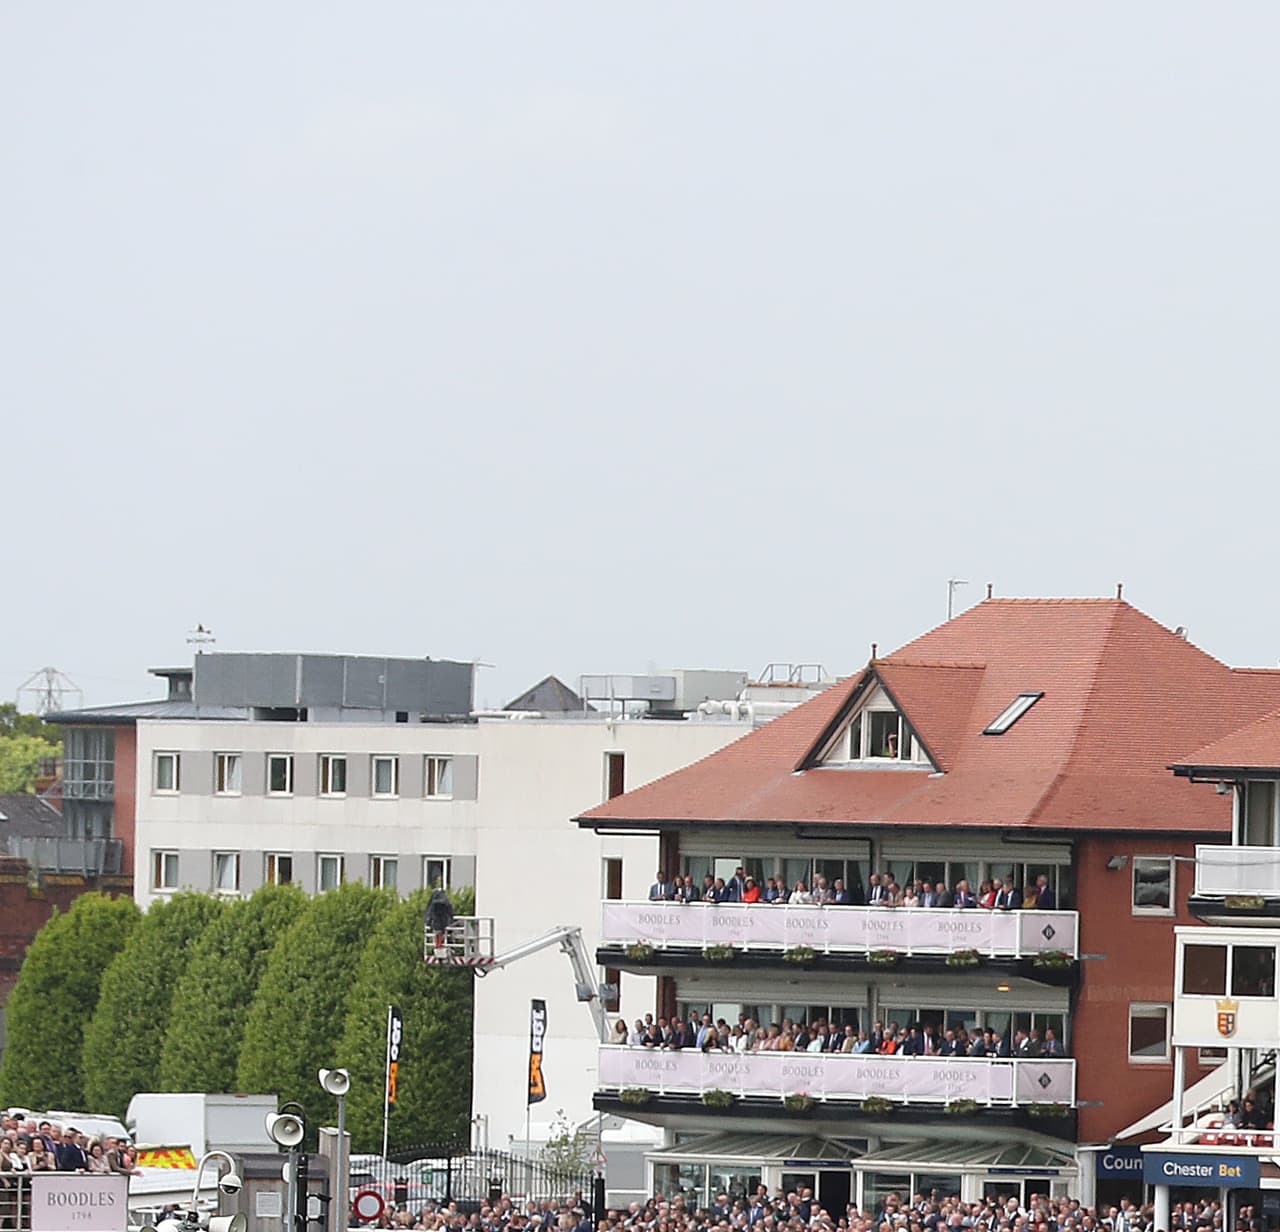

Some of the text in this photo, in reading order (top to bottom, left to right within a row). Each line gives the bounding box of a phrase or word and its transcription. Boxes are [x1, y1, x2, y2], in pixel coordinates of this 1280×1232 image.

[638, 913, 681, 925] BOODLES
[712, 915, 754, 927] BOODLES
[785, 917, 829, 929] BOODLES
[861, 919, 904, 931] BOODLES
[938, 921, 982, 932] BOODLES
[635, 1059, 678, 1071] BOODLES
[856, 1067, 900, 1080] BOODLES
[933, 1069, 977, 1082] BOODLES
[1103, 1154, 1143, 1170] Coun
[1163, 1161, 1241, 1177] Chester Bet
[47, 1191, 115, 1207] BOODLES
